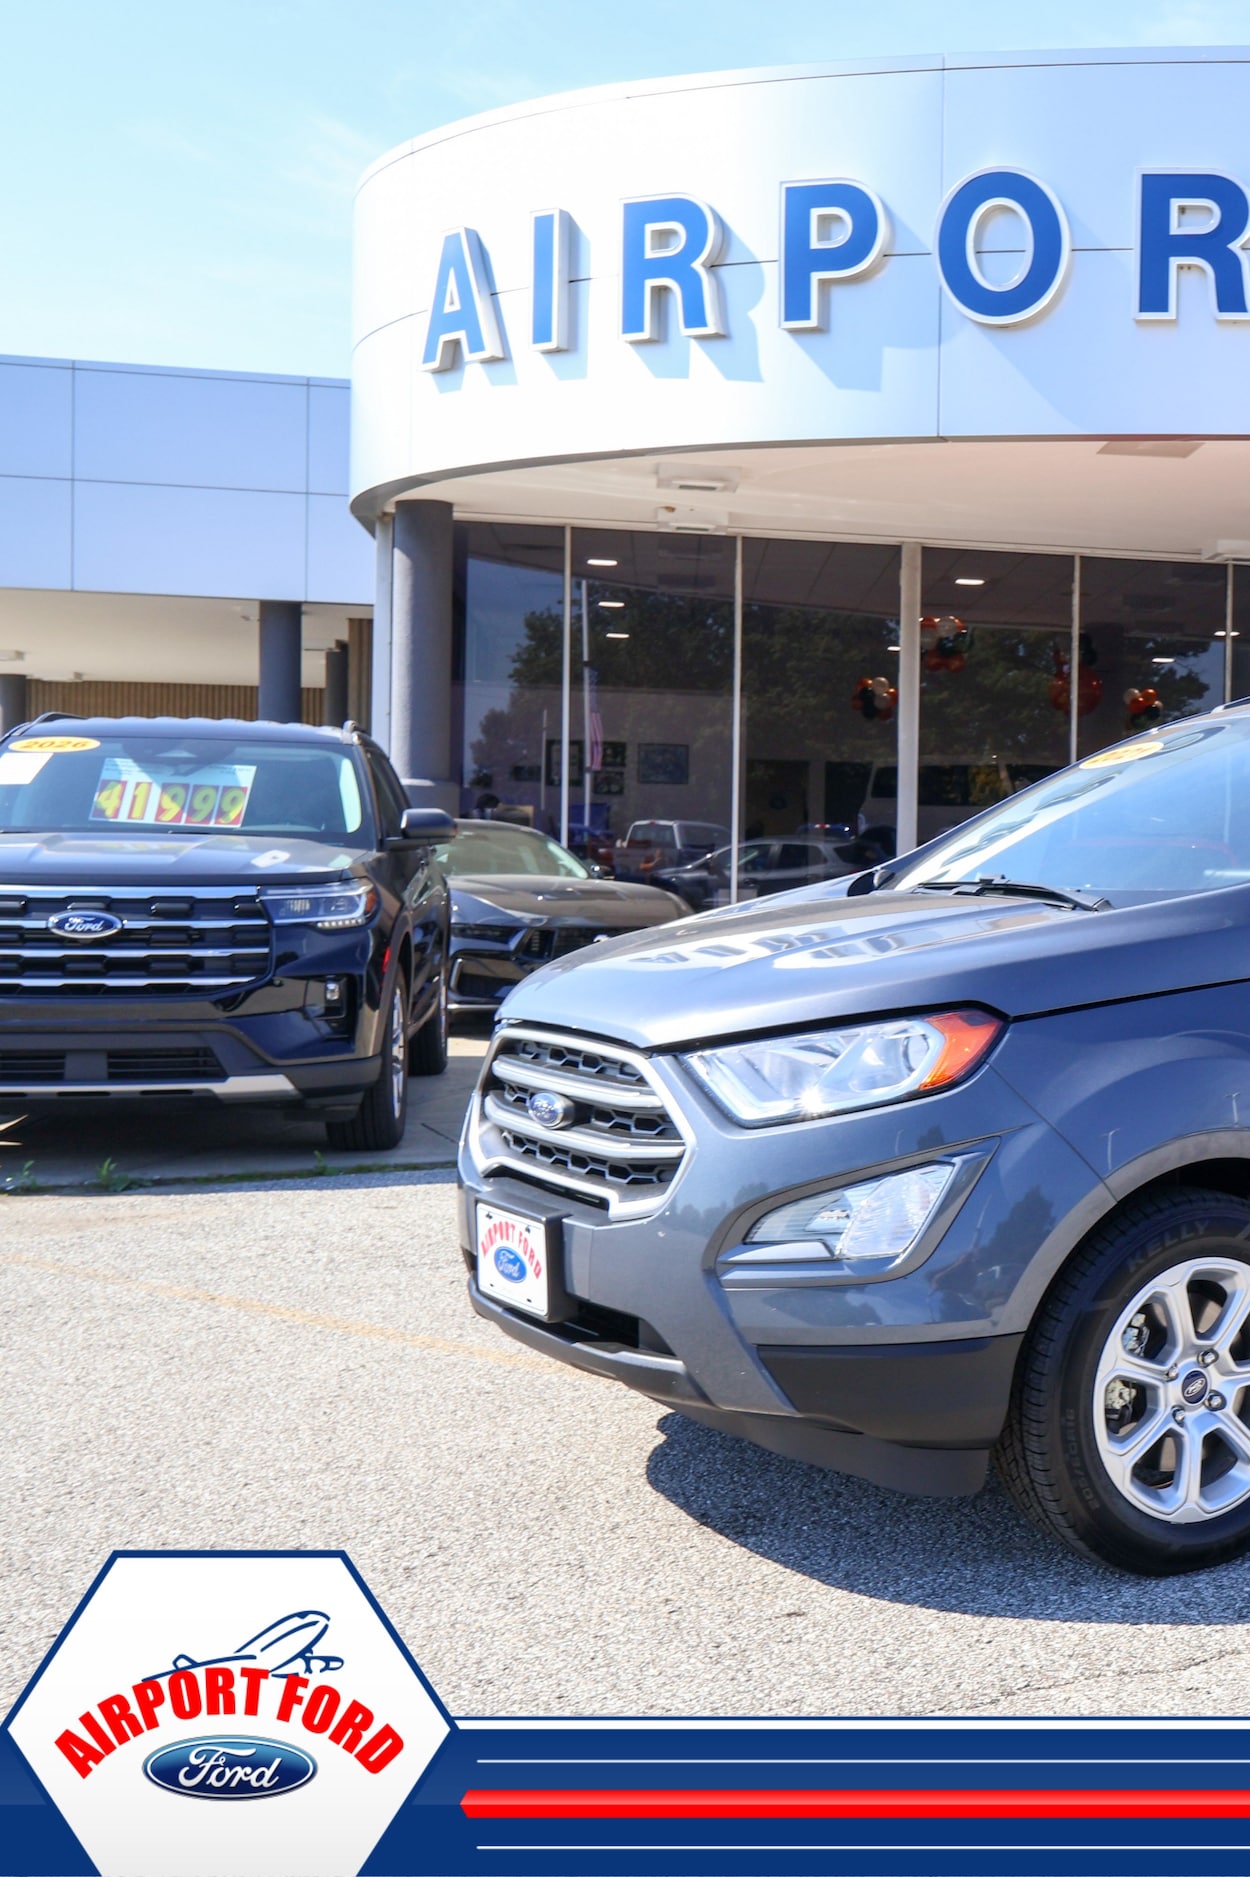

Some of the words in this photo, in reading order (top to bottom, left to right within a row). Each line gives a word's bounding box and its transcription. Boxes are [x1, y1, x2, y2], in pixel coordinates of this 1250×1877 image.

[20, 740, 89, 750] 2026
[96, 782, 245, 822] 41999
[64, 917, 105, 932] Ford
[498, 1250, 521, 1278] Ford
[518, 1230, 542, 1280] FORD
[1126, 1220, 1210, 1274] KELLY
